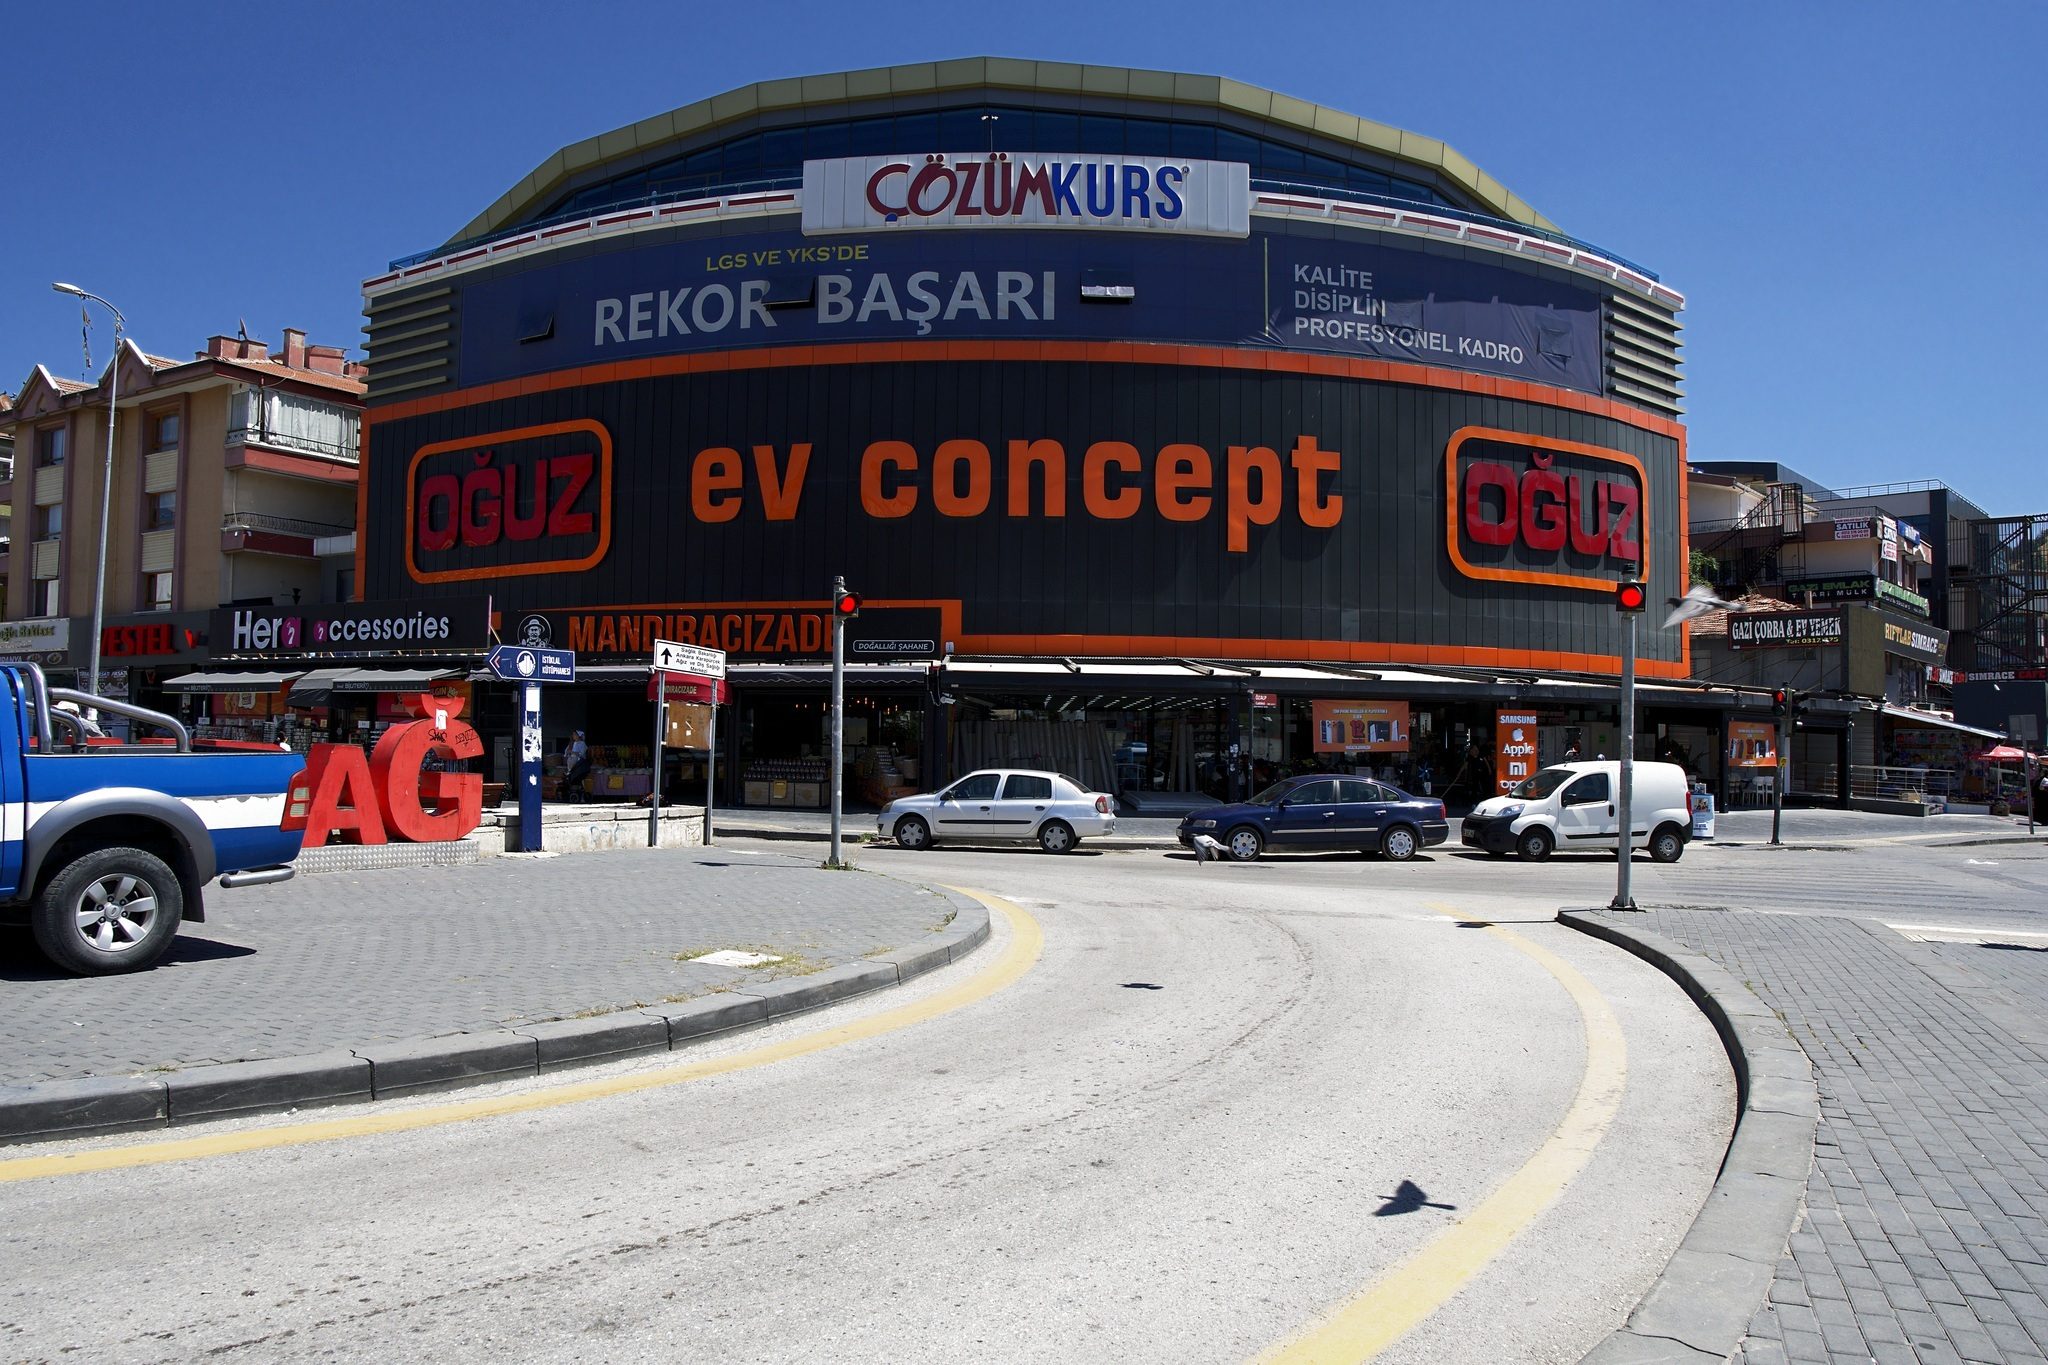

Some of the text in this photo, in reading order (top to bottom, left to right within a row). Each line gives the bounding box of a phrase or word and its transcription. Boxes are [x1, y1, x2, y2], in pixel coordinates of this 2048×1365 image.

[867, 153, 1183, 221] ÇÖZÜMKURS
[706, 254, 748, 271] LGS
[753, 251, 781, 267] VE
[1294, 264, 1373, 290] KALİTE
[594, 271, 1056, 346] REKOR BAŞARI
[1295, 317, 1524, 365] PROFESYONEL KADRO
[418, 450, 594, 551] OĞUZ
[691, 435, 1343, 552] ev concept
[1466, 451, 1640, 561] OĞUZ
[1836, 521, 1869, 531] SATILIK
[1823, 580, 1870, 590] EMLAK
[1732, 616, 1753, 640] GAZİ
[1754, 620, 1785, 644] ÇORBA
[1786, 619, 1794, 637] &
[1795, 619, 1808, 637] EV
[676, 652, 694, 660] Ankara
[898, 643, 929, 651] ŞAHANE
[541, 655, 561, 665] İSTİKLAL
[1968, 671, 2015, 681] SIMRACE
[1500, 715, 1537, 724] SAMSUNG
[1502, 742, 1535, 757] Apple
